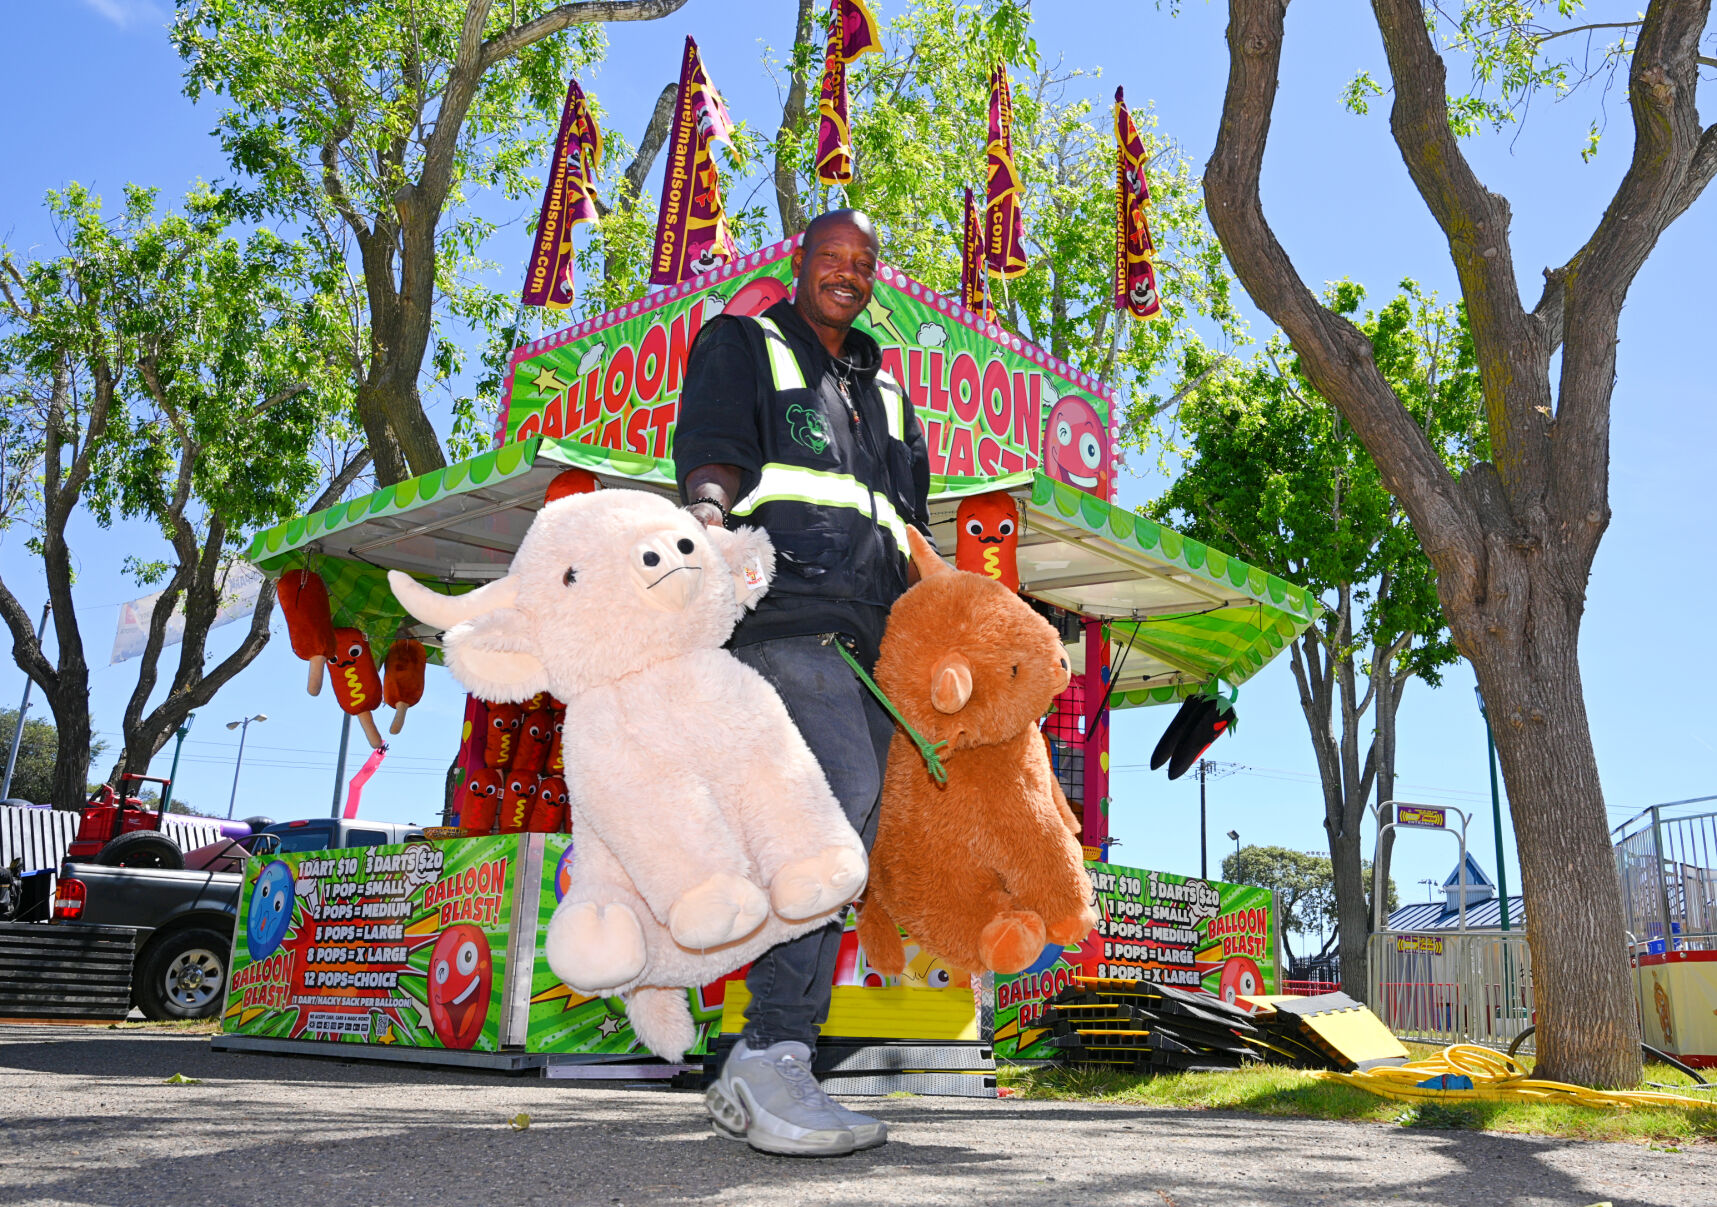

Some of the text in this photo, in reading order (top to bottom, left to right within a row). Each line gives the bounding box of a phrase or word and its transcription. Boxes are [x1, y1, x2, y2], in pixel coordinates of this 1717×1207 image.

[881, 347, 1042, 457] ALLOON
[337, 856, 358, 877] $10
[418, 851, 444, 874] $20
[325, 883, 331, 898] 1
[333, 882, 356, 897] POP
[365, 880, 405, 896] SMALL
[424, 857, 507, 910] BALLOON
[1090, 873, 1116, 892] ART
[1119, 876, 1141, 897] $10
[1199, 887, 1220, 906] $20
[314, 905, 321, 919] 2
[323, 904, 353, 919] POPS
[362, 902, 412, 917] MEDIUM
[440, 895, 503, 927] BLAST!
[1108, 899, 1115, 914] 1
[1117, 900, 1143, 916] POP
[1152, 904, 1190, 923] SMALL
[315, 926, 323, 941] 5
[324, 925, 355, 941] POPS
[364, 924, 404, 940] LARGE
[1099, 921, 1106, 934] 2
[1109, 922, 1143, 938] POPS
[1152, 926, 1198, 944] MEDIUM
[1207, 906, 1267, 940] BALLOON
[307, 948, 314, 962] 8
[316, 947, 347, 962] POPS
[355, 947, 364, 961] X
[367, 946, 407, 962] LARGE
[1104, 943, 1112, 957] 5
[1115, 944, 1148, 960] POPS
[1157, 948, 1194, 964] LARGE
[1223, 934, 1267, 961] BLAST!
[231, 950, 295, 993] BALLOON
[304, 971, 315, 986] 12
[1098, 963, 1105, 978] 8
[1109, 965, 1143, 980] POPS
[1152, 969, 1162, 983] X
[1163, 969, 1200, 986] LARGE
[243, 984, 290, 1011] BLAST!
[341, 996, 360, 1006] SACK
[361, 997, 374, 1007] PER
